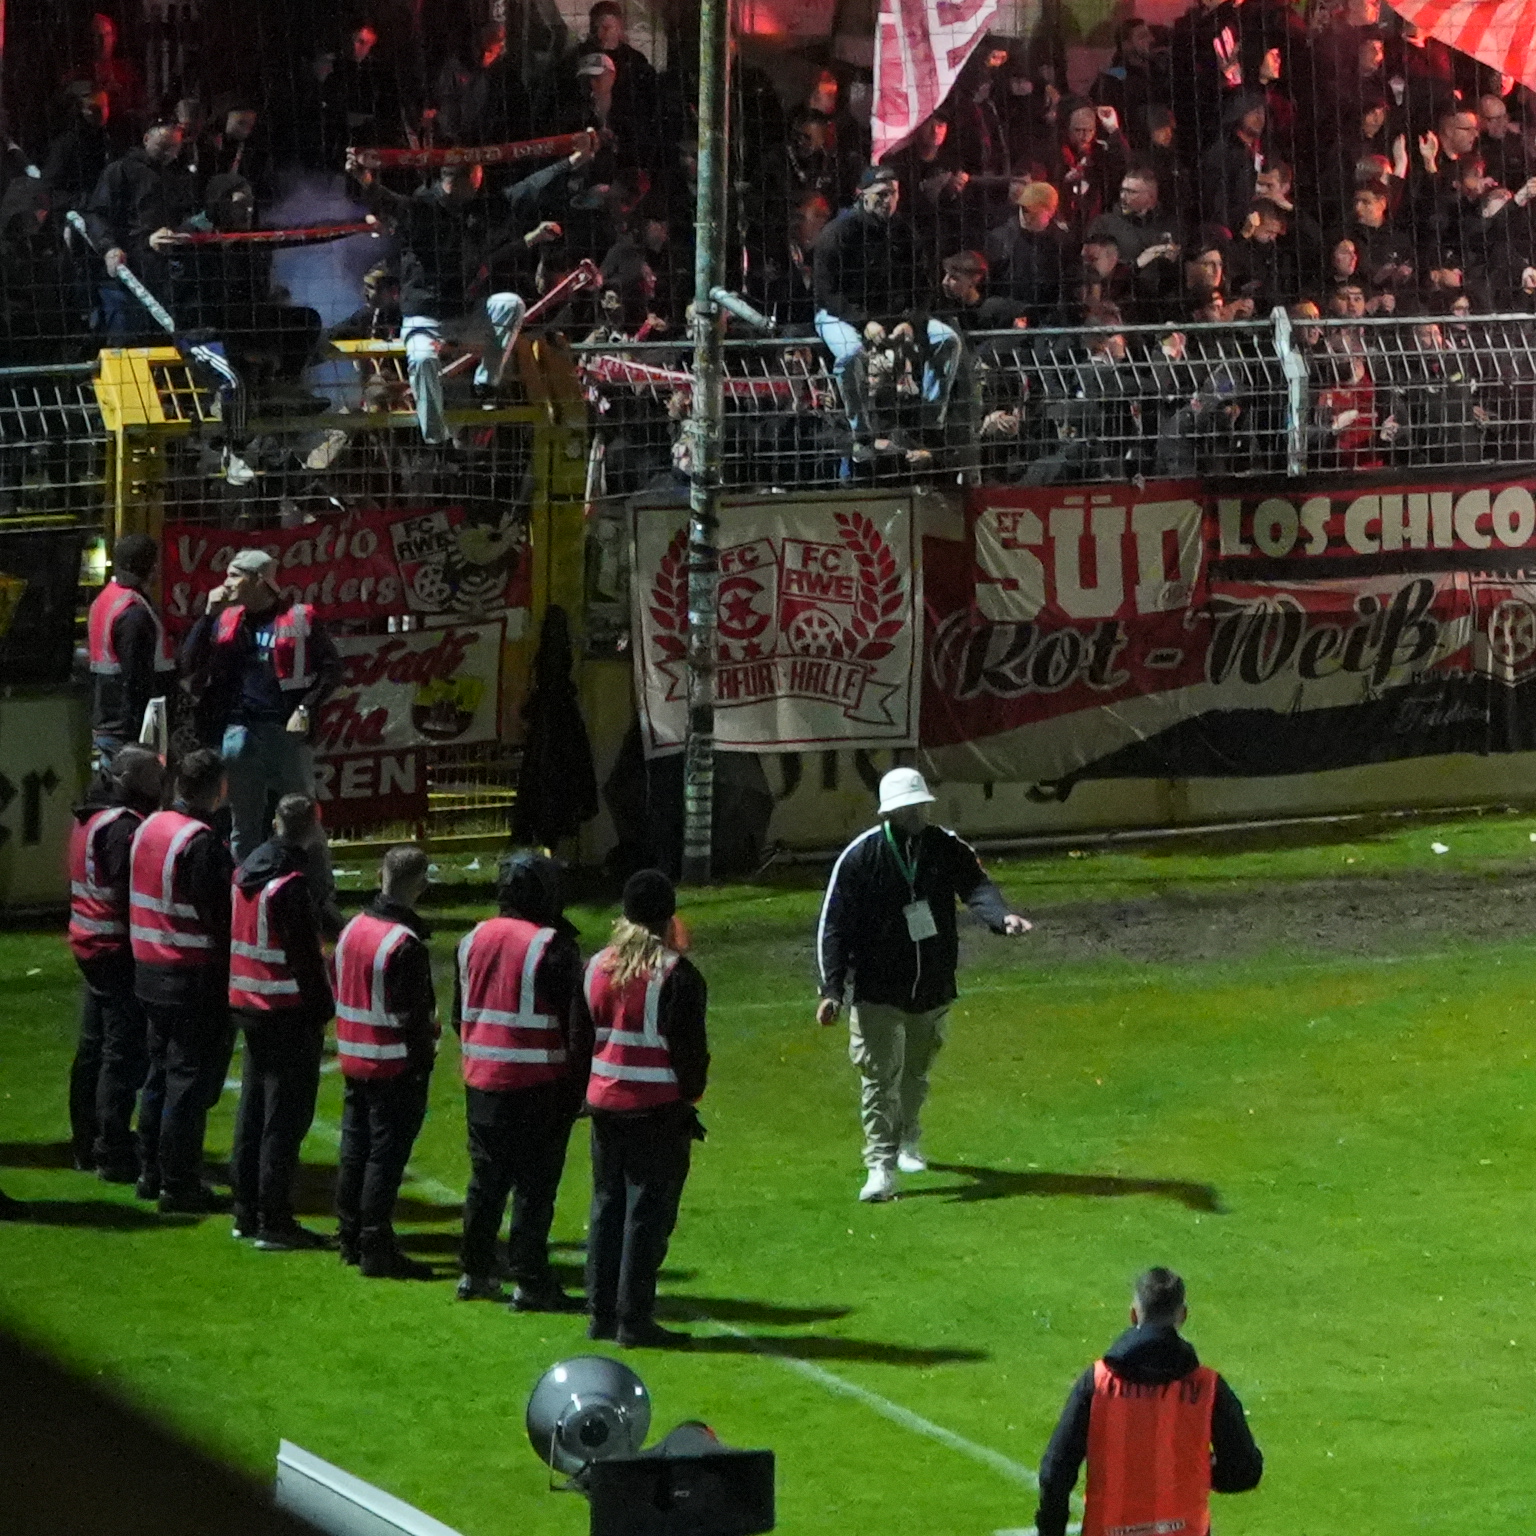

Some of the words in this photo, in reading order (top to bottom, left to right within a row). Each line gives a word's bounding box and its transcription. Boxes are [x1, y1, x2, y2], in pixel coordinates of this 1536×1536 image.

[1218, 497, 1332, 558] LOS
[802, 546, 841, 573] FC
[975, 494, 1203, 621] SÜD
[784, 568, 854, 598] RWE
